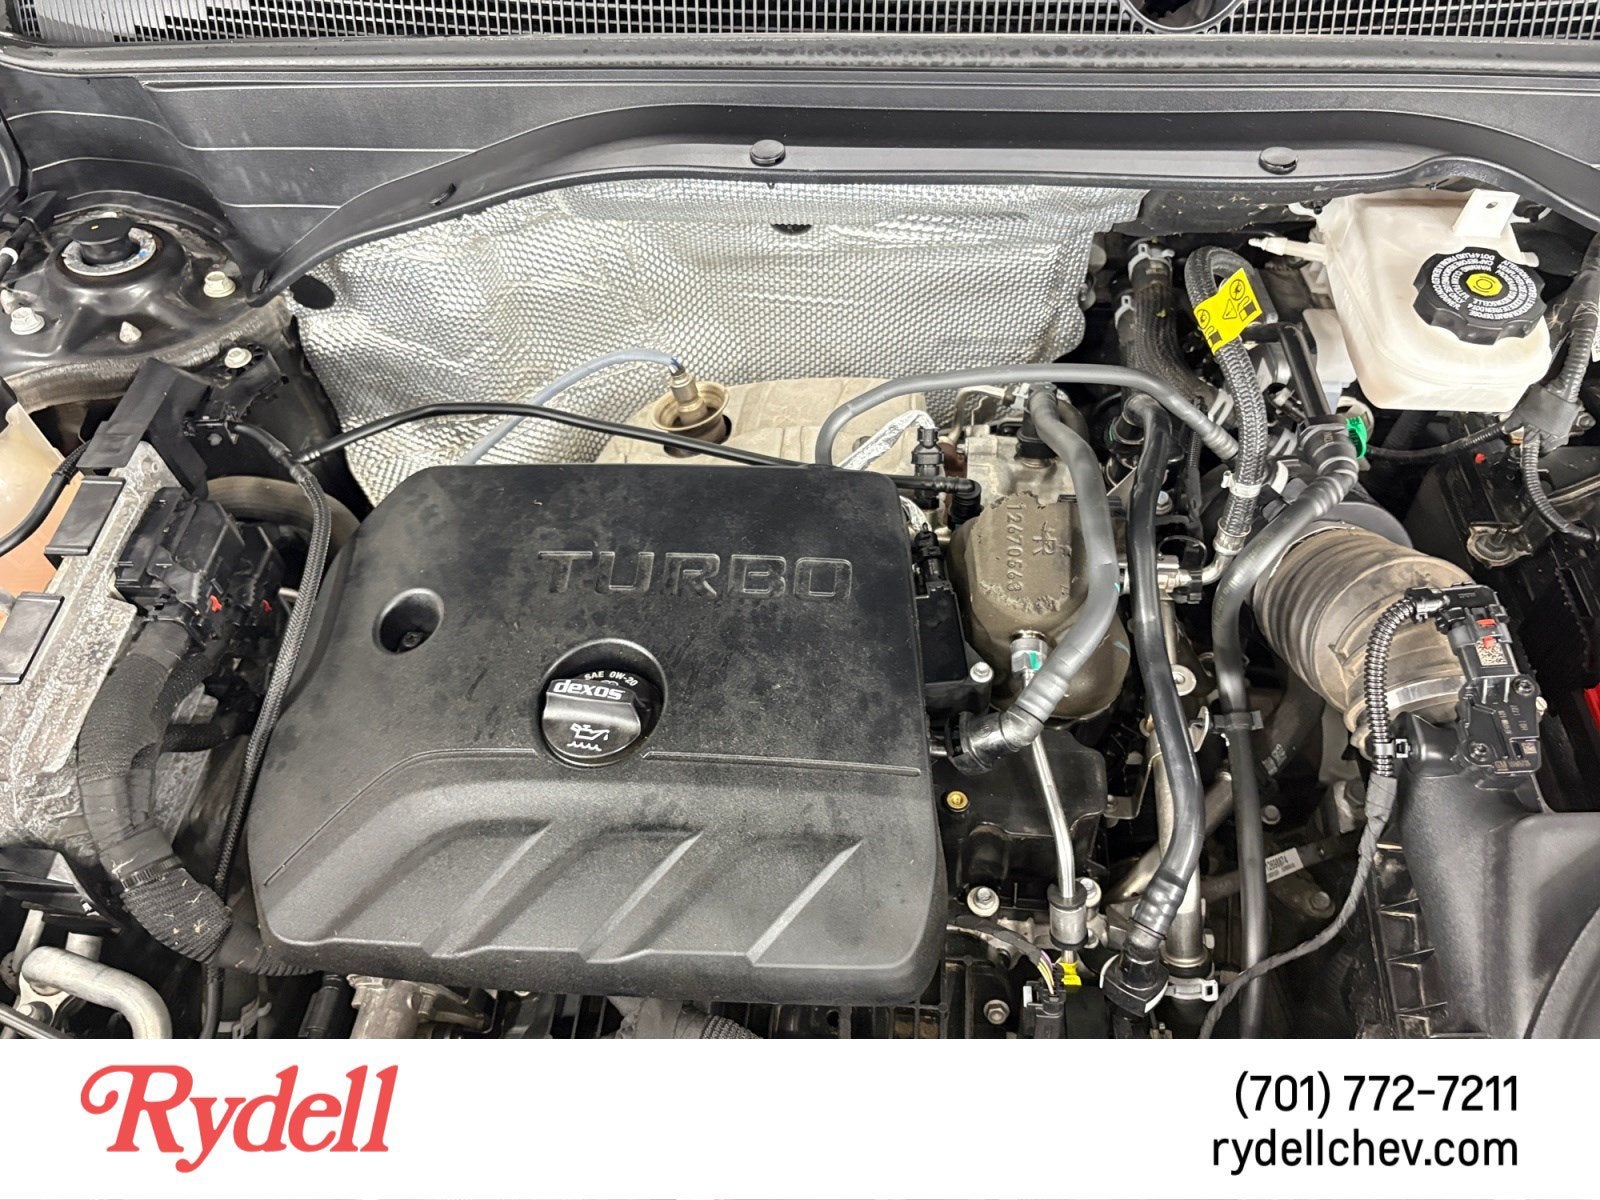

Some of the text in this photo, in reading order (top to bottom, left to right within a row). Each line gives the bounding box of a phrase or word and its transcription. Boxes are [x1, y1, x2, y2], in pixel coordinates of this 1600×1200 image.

[537, 550, 853, 601] TURBO
[584, 670, 639, 687] SAE 0W-20
[553, 679, 626, 700] dexos
